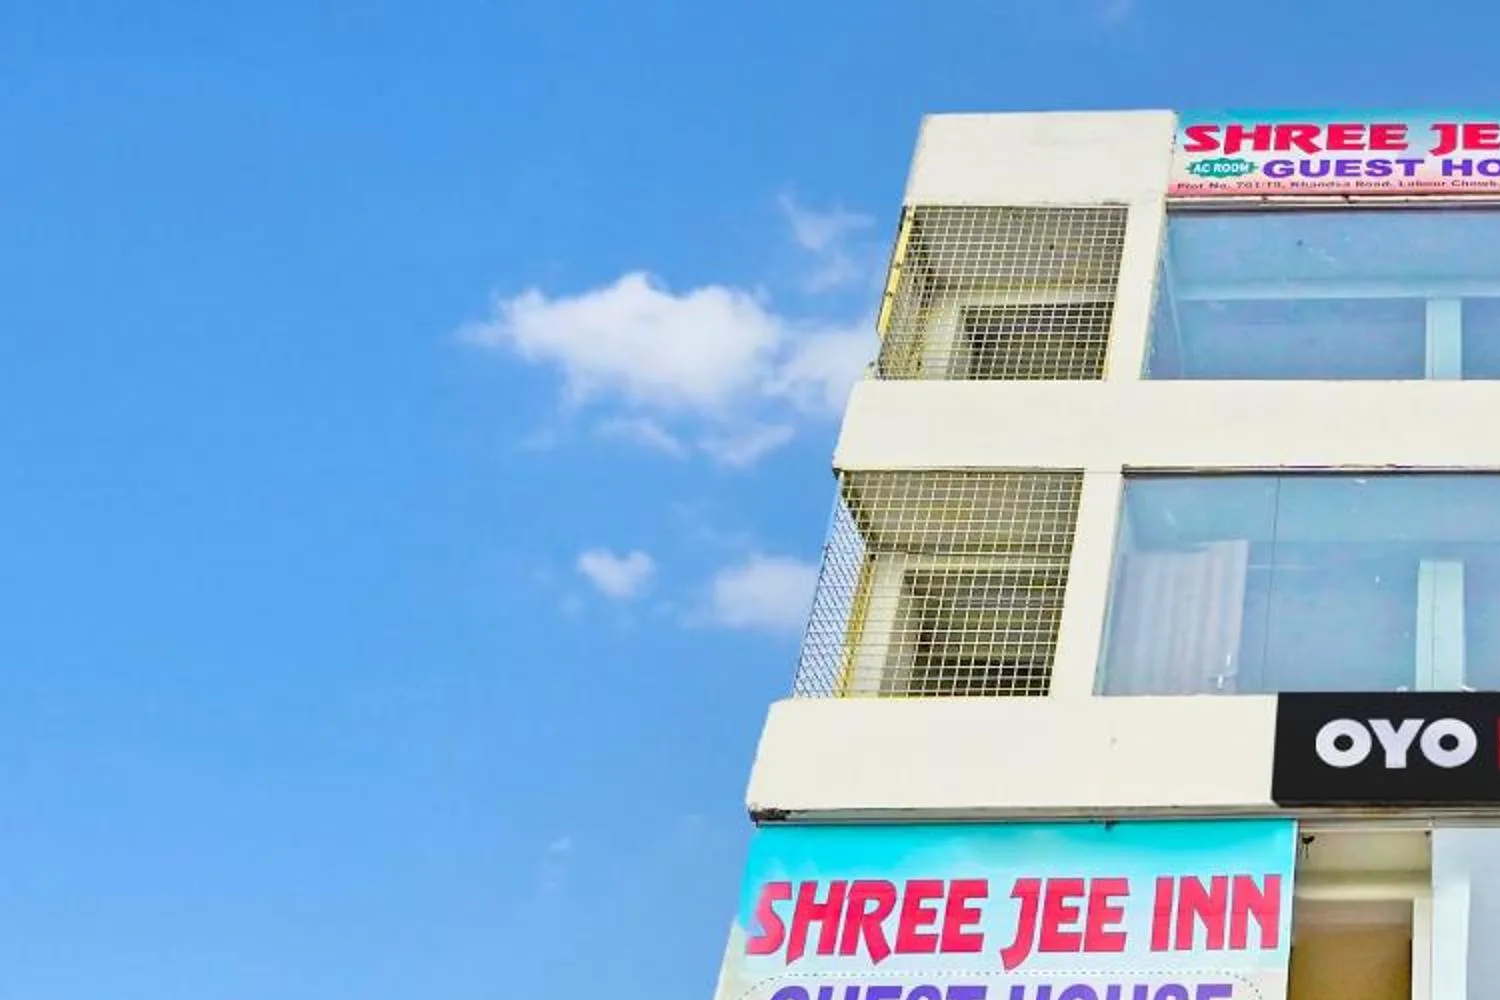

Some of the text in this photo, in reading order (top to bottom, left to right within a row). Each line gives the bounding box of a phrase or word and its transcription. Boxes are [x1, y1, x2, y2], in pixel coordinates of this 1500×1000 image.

[1184, 122, 1409, 154] SHREE
[1193, 160, 1250, 173] AC ROOM
[1262, 158, 1425, 178] GUEST
[1315, 718, 1478, 769] OYO
[744, 873, 1282, 970] SHREE JEE INN
